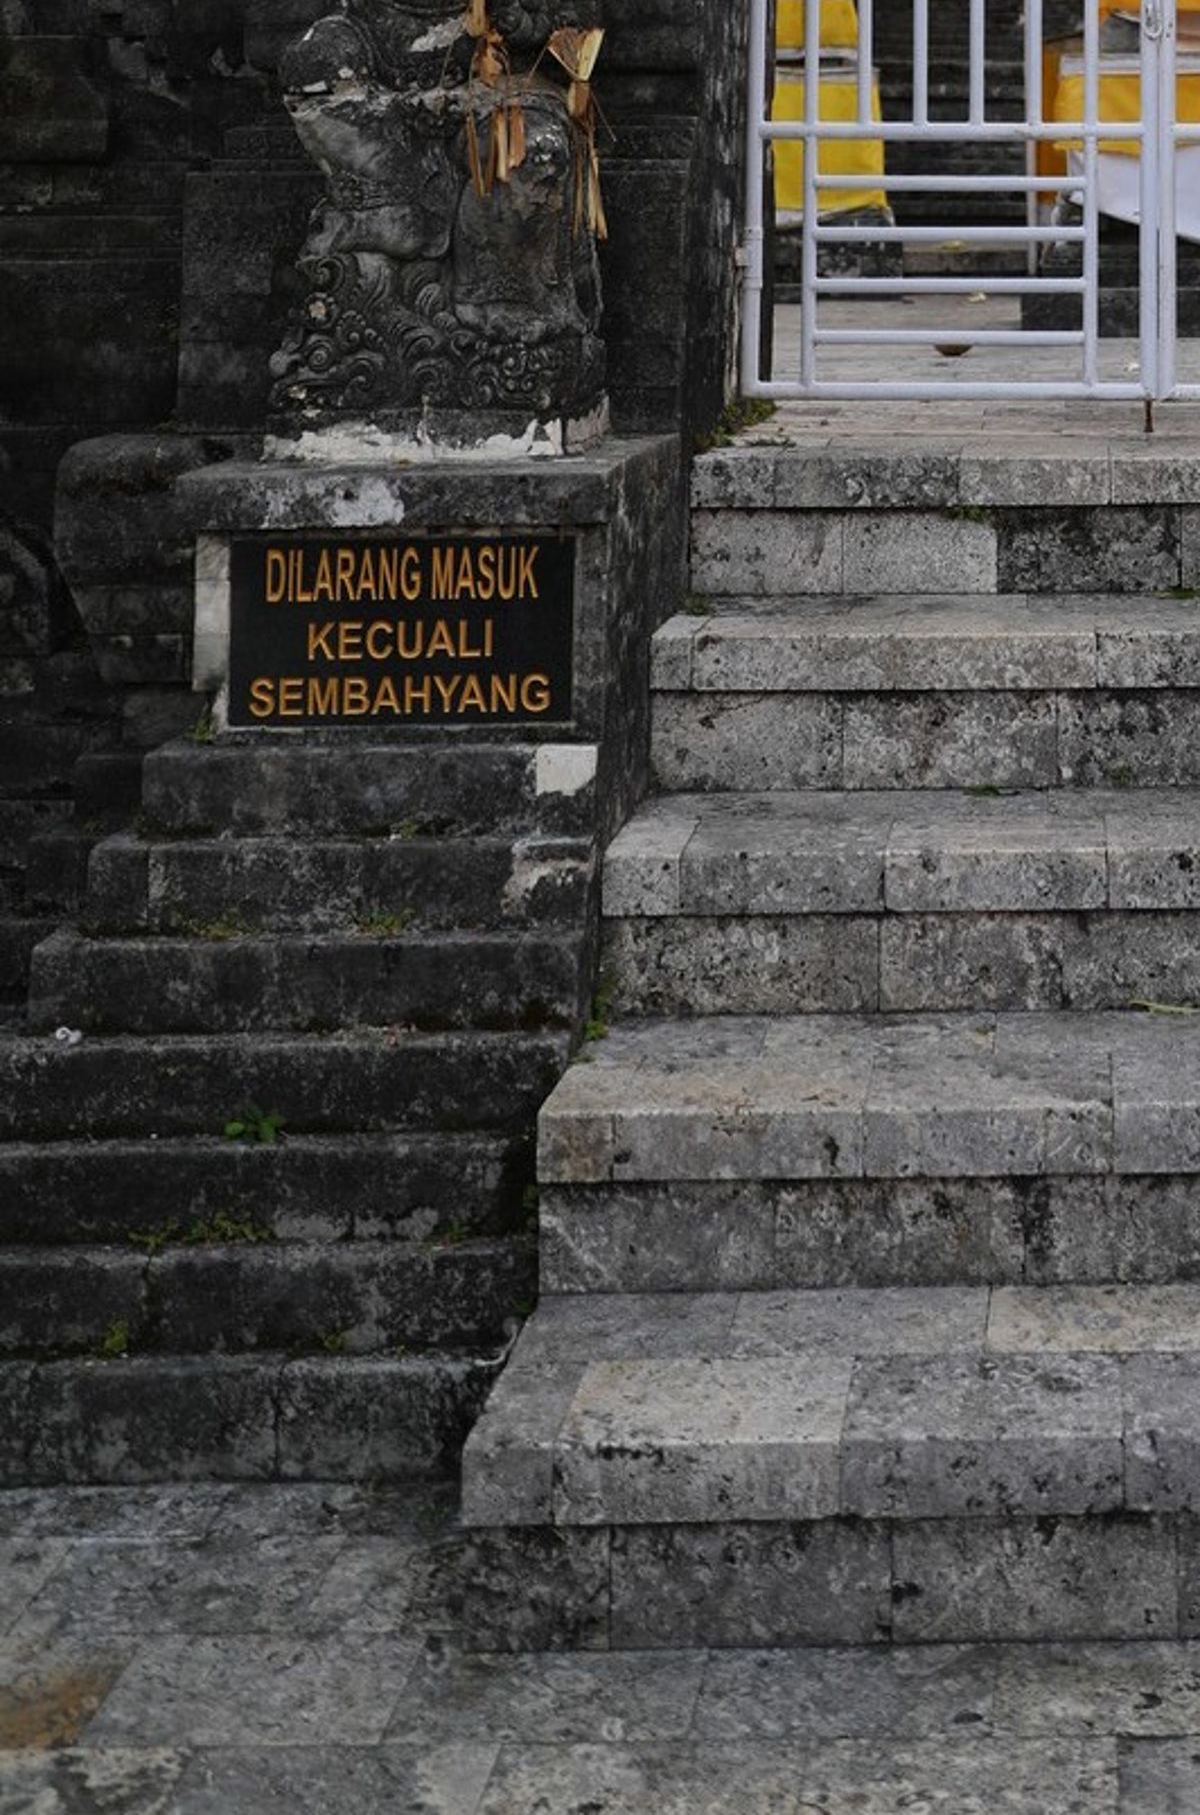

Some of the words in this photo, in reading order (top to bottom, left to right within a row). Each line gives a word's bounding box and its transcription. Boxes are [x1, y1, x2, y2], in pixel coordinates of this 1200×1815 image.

[265, 547, 420, 602] DILARANG
[431, 545, 539, 600] MASUK
[307, 619, 493, 660] KECUALI
[250, 673, 550, 717] SEMBAHYANG
